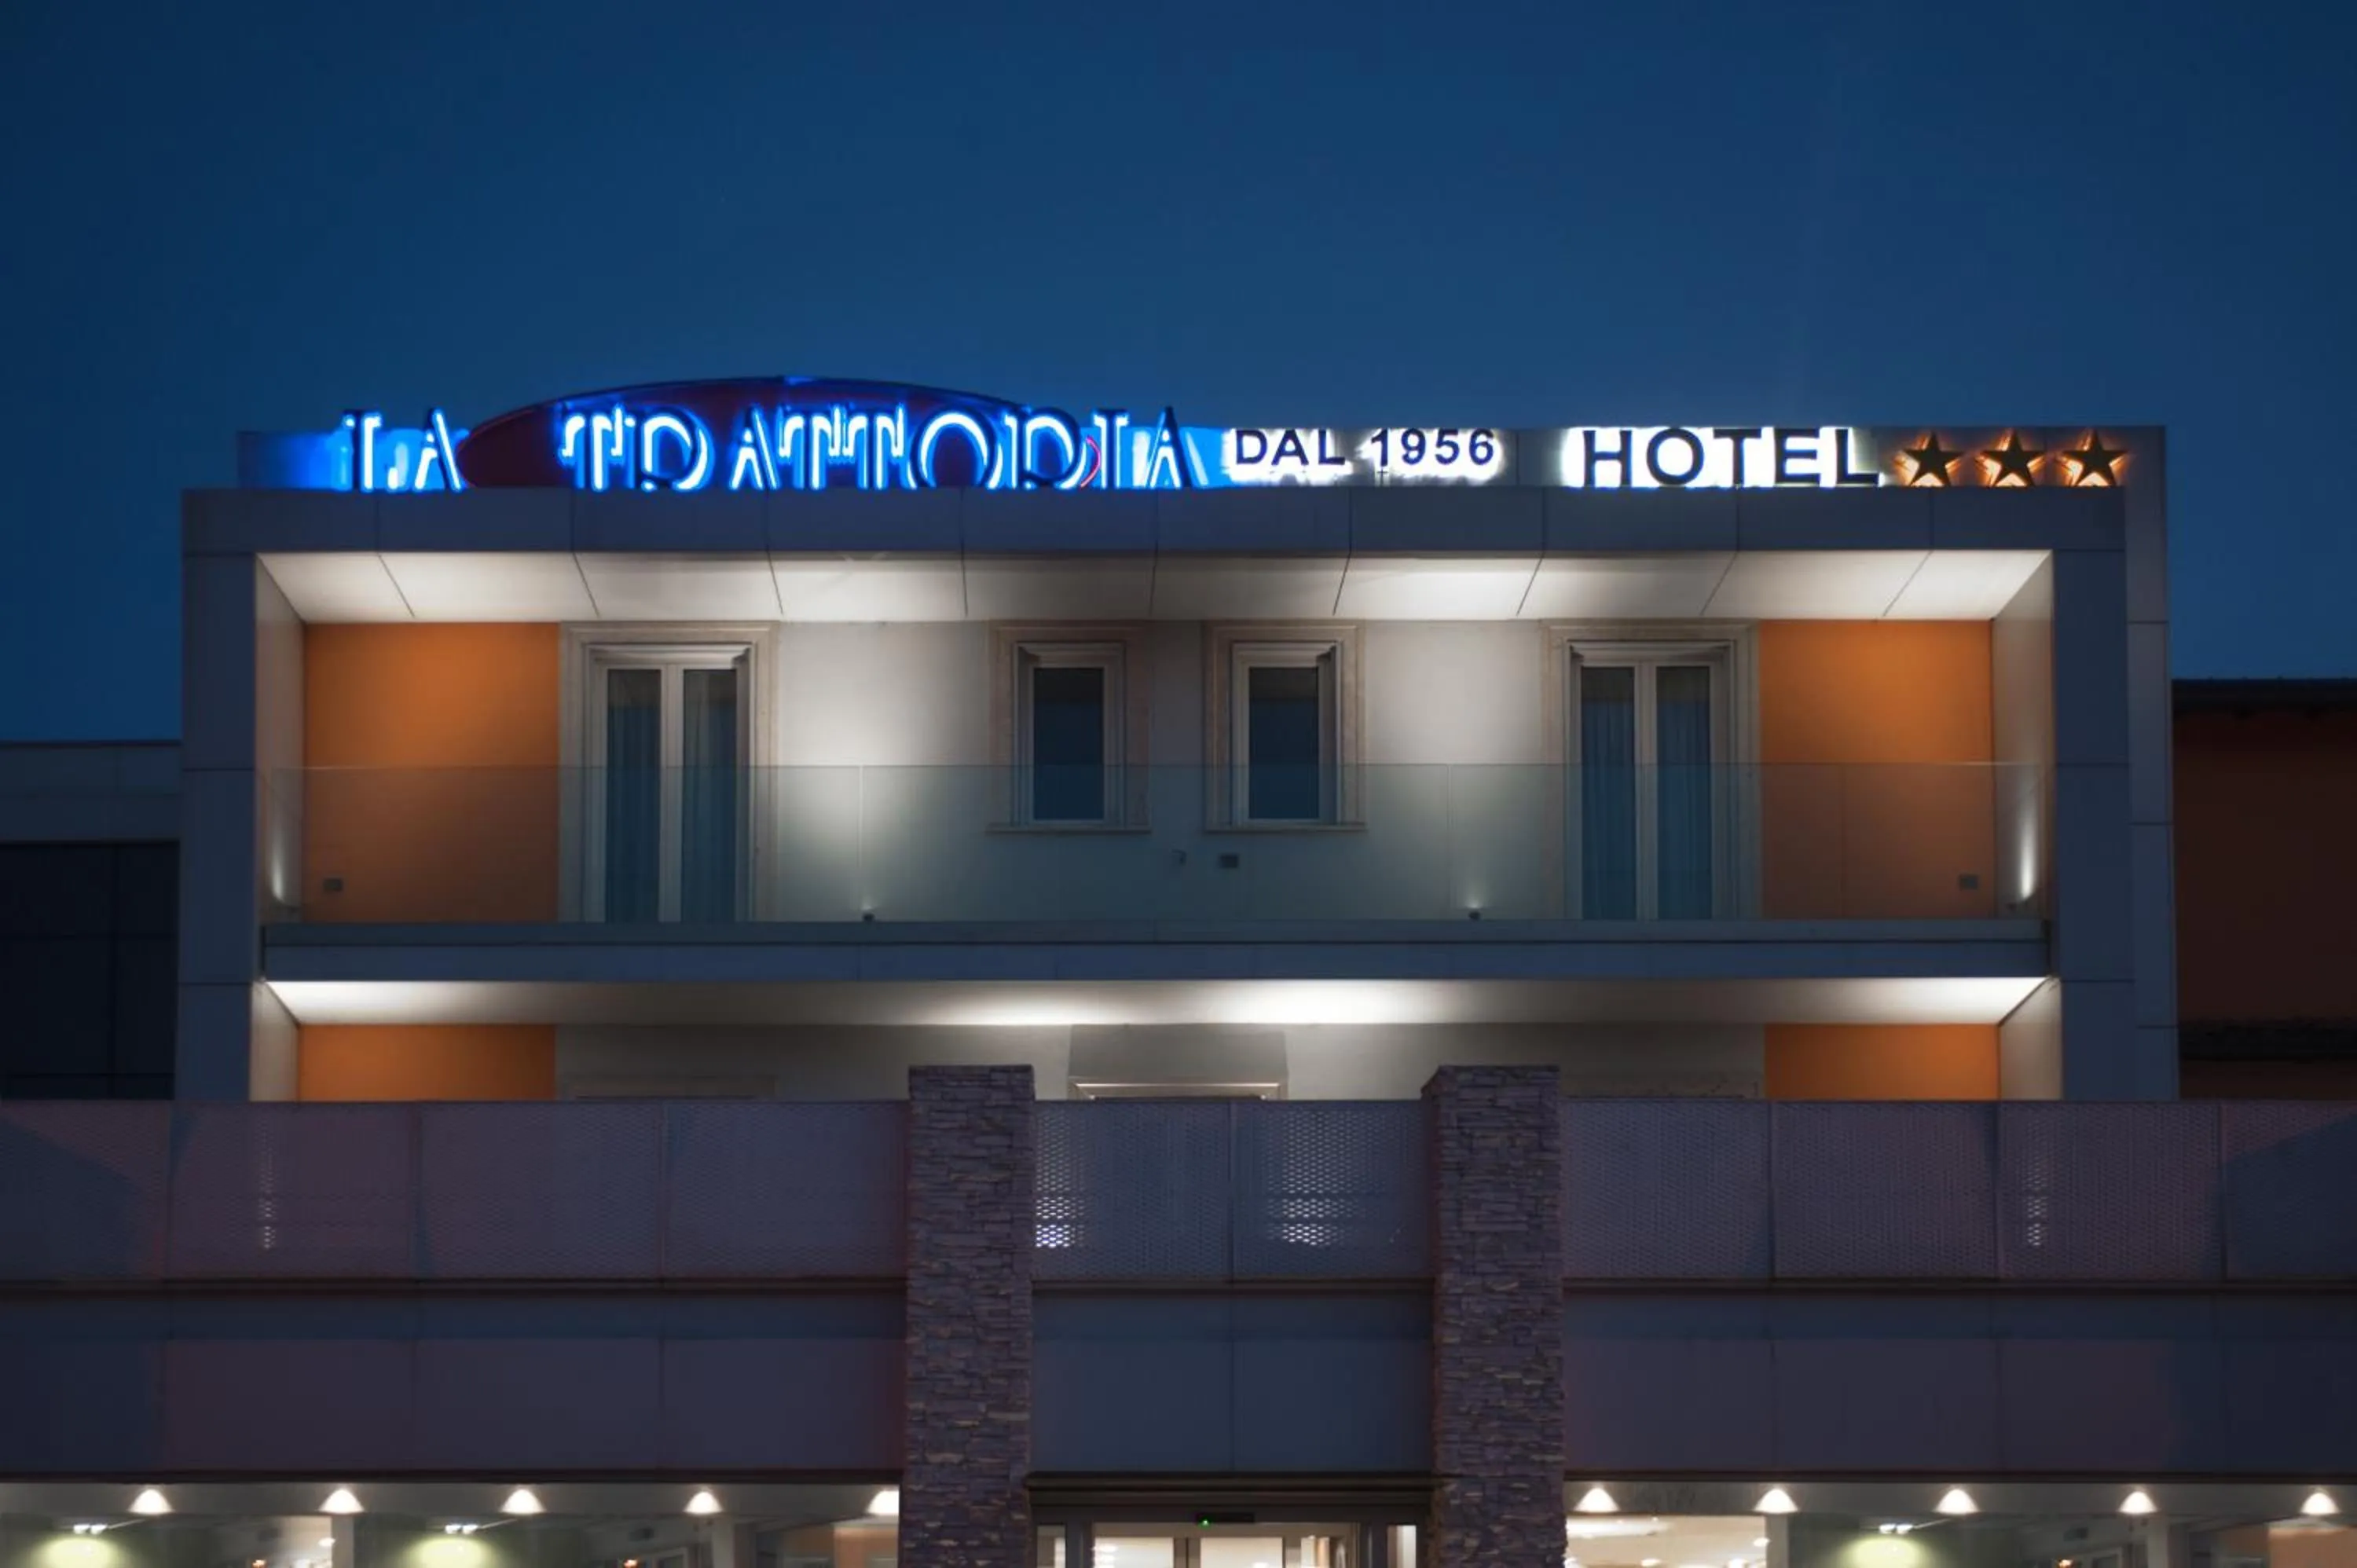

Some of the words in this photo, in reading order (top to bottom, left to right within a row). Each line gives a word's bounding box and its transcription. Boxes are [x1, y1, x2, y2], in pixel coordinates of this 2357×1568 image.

[341, 408, 464, 489] LA
[1234, 429, 1346, 466] DAL
[1371, 428, 1495, 467] 1956
[1582, 427, 1880, 488] HOTEL
